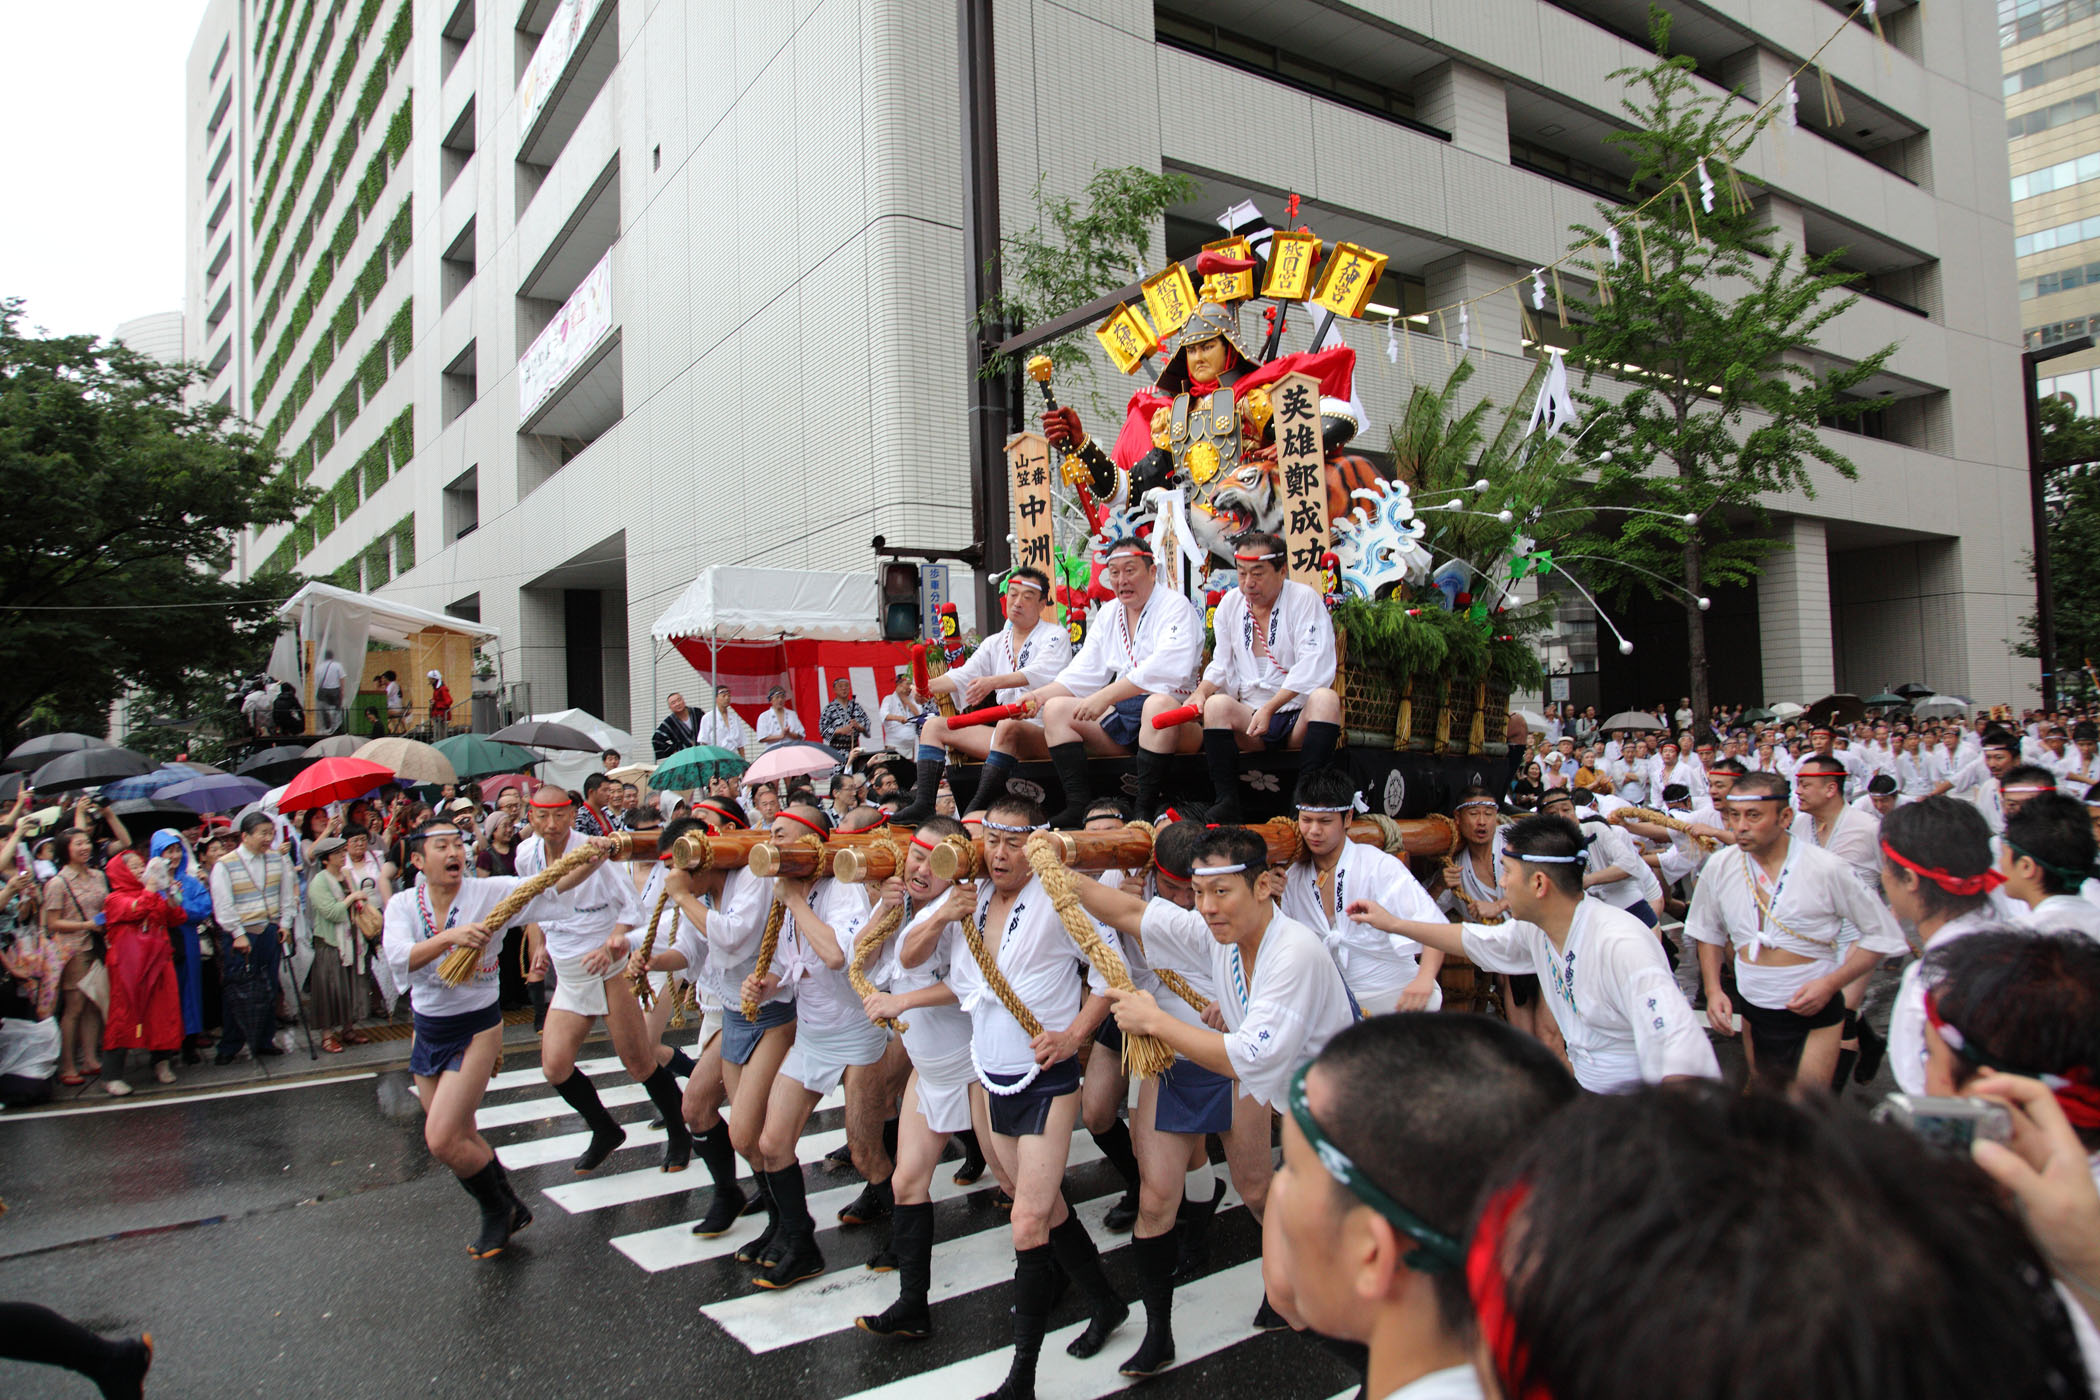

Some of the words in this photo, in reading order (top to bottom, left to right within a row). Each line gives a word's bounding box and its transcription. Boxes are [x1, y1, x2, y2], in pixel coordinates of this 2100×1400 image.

[1332, 256, 1361, 304] 大神宮
[1280, 384, 1327, 574] 英雄鄭成功
[1018, 494, 1054, 607] 中洲
